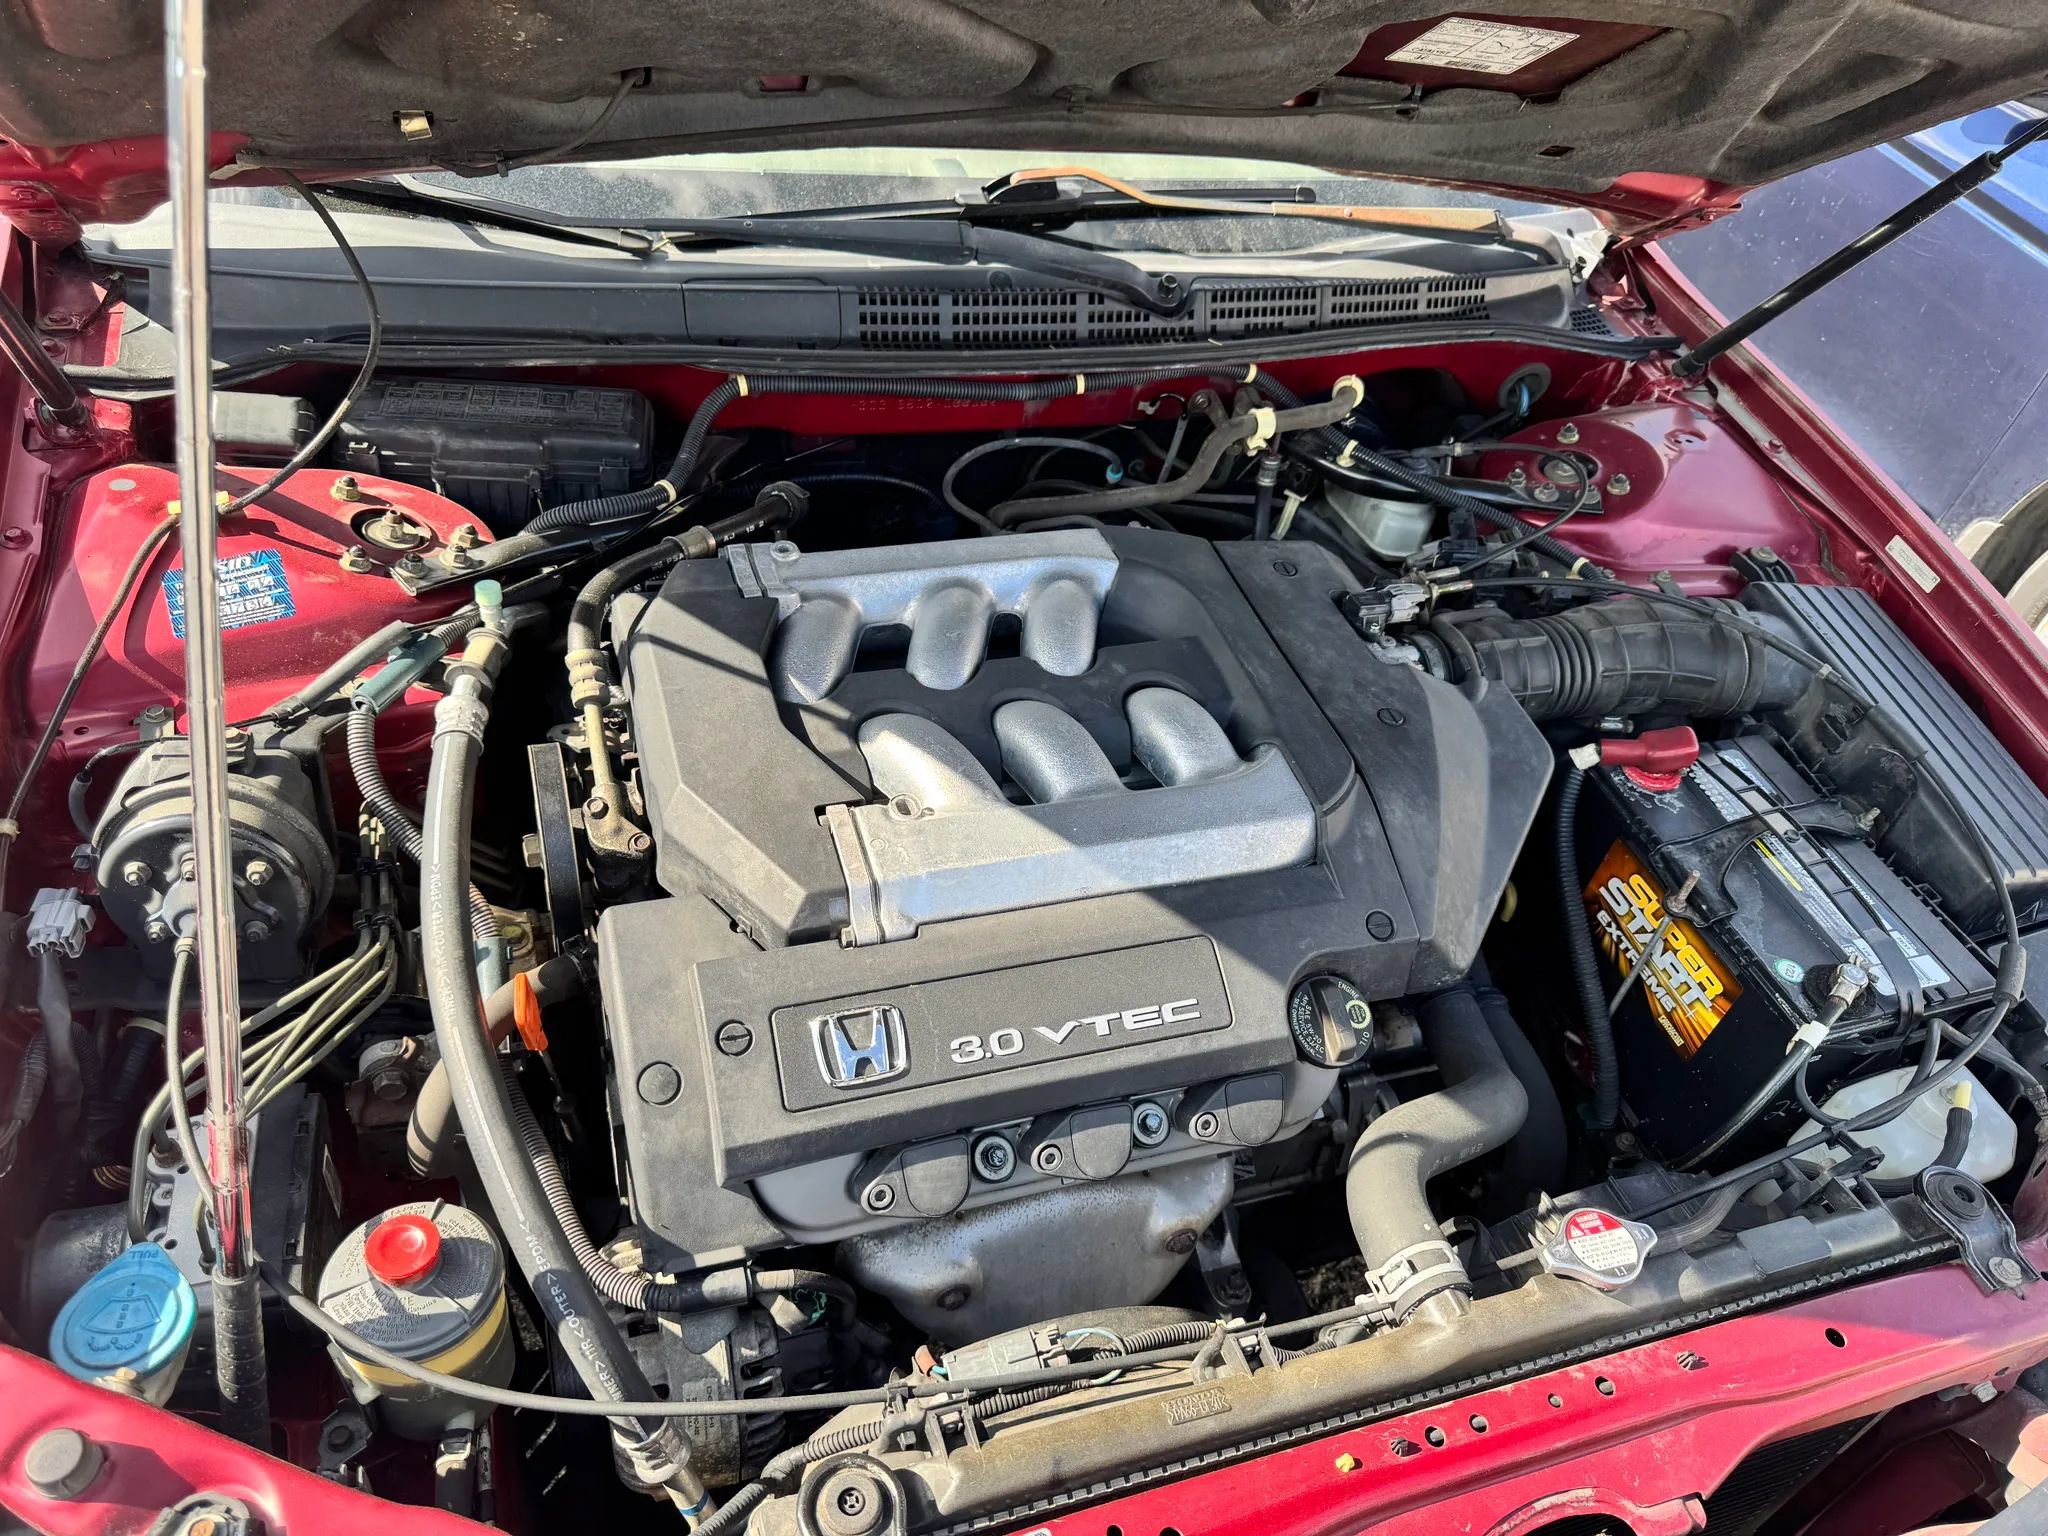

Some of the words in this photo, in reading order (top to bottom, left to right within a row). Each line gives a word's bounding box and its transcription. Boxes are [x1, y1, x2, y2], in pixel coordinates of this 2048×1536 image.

[1599, 876, 1712, 1009] START
[1623, 873, 1724, 1000] SUPER
[1596, 909, 1677, 1013] EXTREME
[1338, 981, 1360, 1000] ENGINE
[1297, 1006, 1308, 1037] SERVICE
[1304, 1005, 1312, 1020] SAE
[950, 1028, 1024, 1065] 3.0
[1031, 998, 1201, 1045] VTEC
[1359, 1031, 1370, 1046] OIL
[1297, 1034, 1316, 1056] MANUAL
[128, 1250, 159, 1260] PULL
[1614, 1266, 1628, 1277] 1.1
[371, 1287, 414, 1306] NOTICE
[549, 1285, 581, 1328] OUTER
